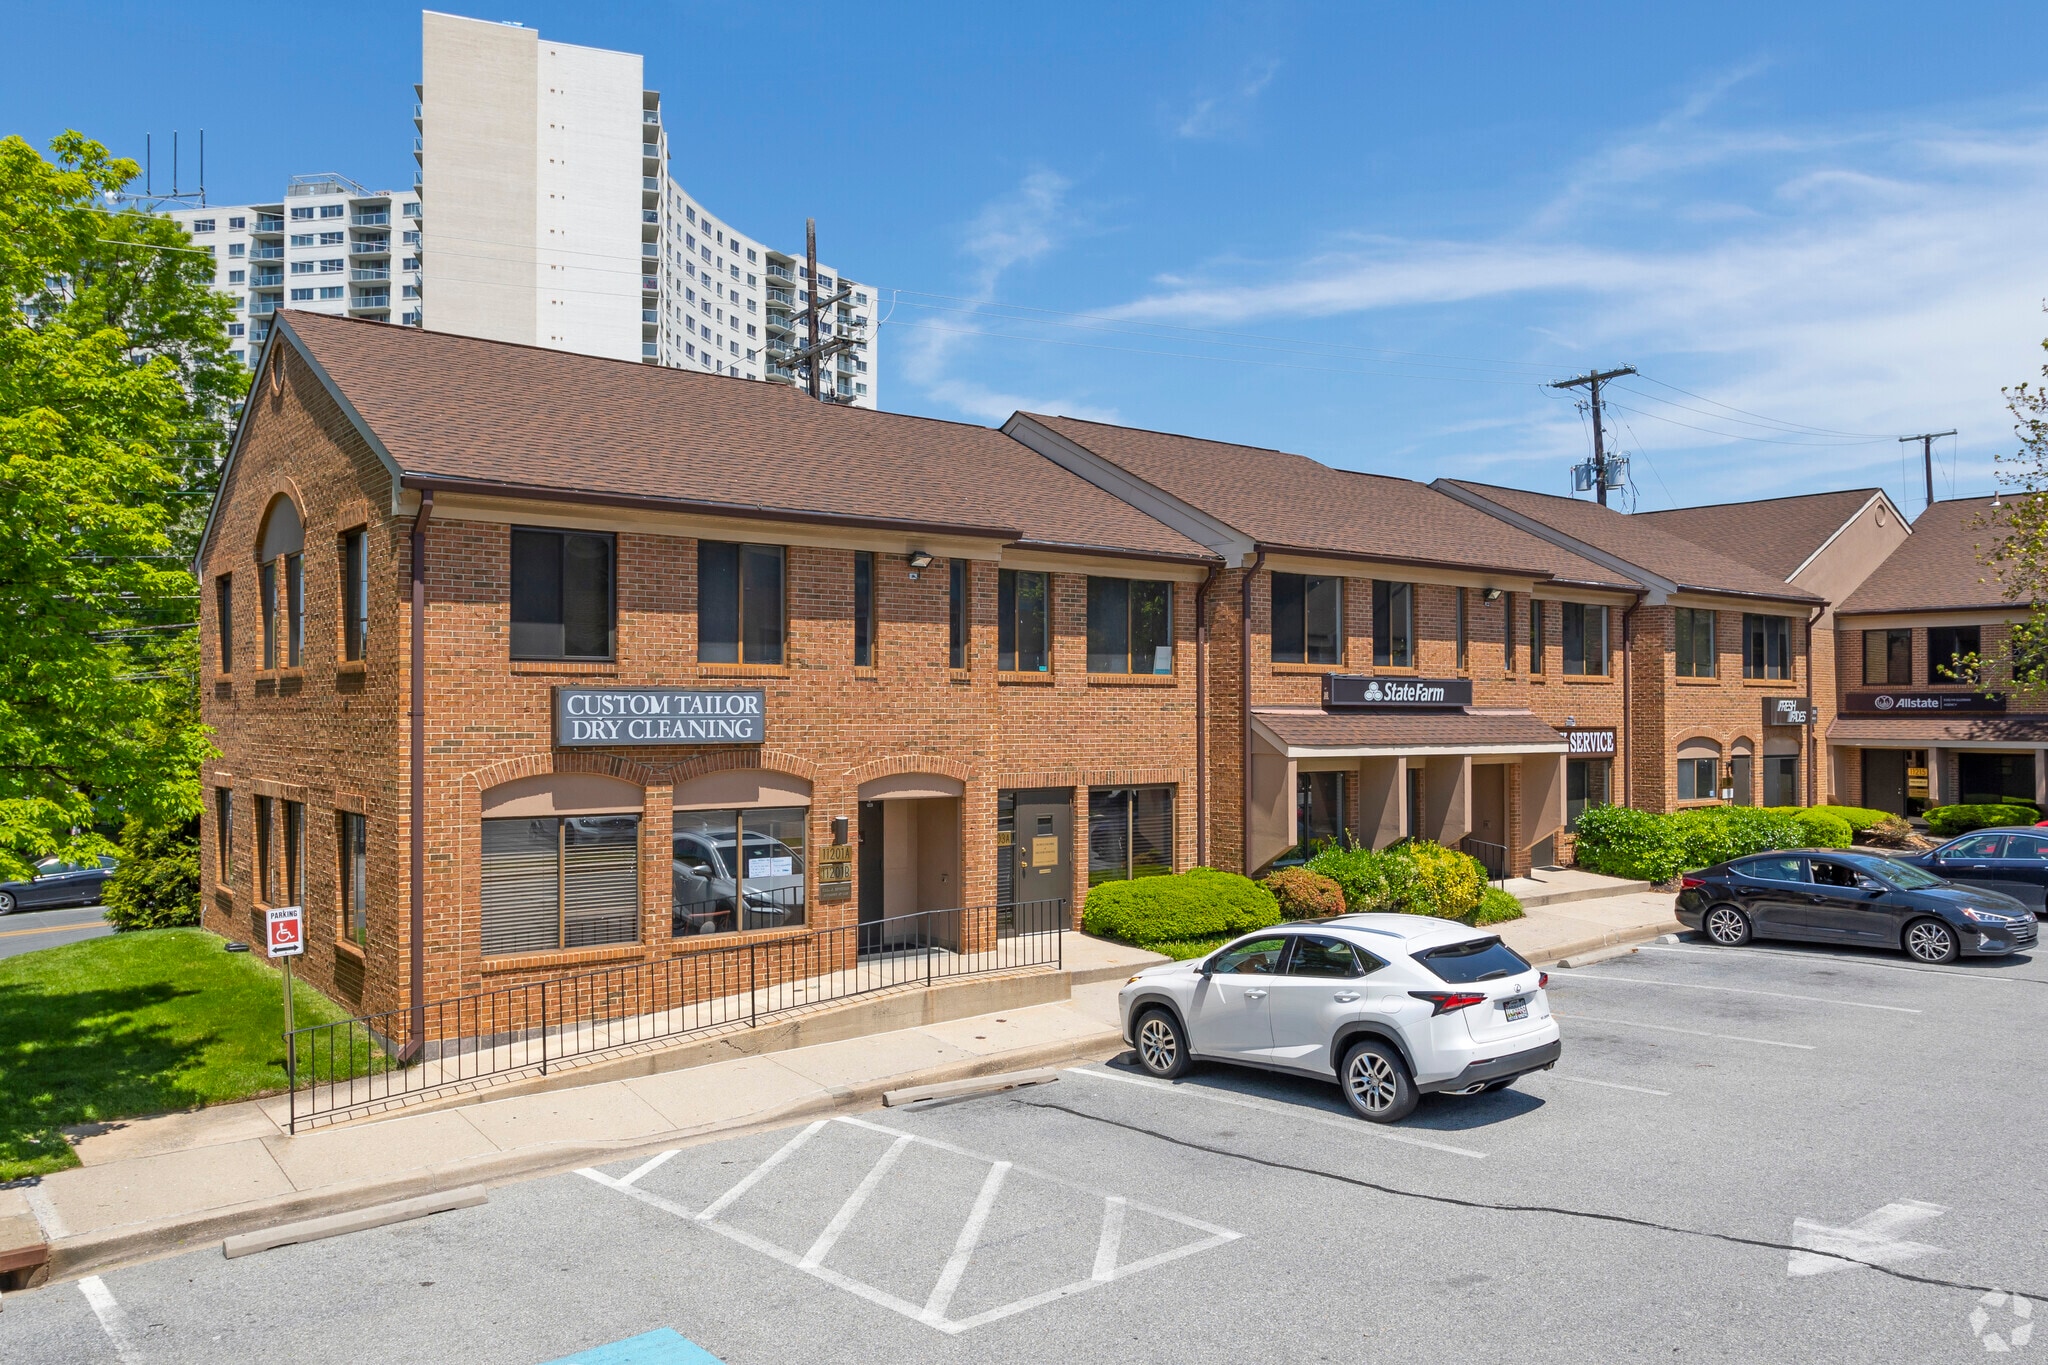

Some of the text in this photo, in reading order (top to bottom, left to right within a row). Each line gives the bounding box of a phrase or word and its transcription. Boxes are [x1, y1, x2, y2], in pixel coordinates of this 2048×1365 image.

[566, 694, 760, 715] CUSTOM TAILOR
[1895, 698, 1939, 708] Allstate
[572, 718, 753, 740] DRY CLEANING
[1570, 731, 1614, 752] SERVICE
[822, 847, 850, 860] 11201A
[821, 865, 850, 879] 11201B
[270, 910, 298, 919] PARKING
